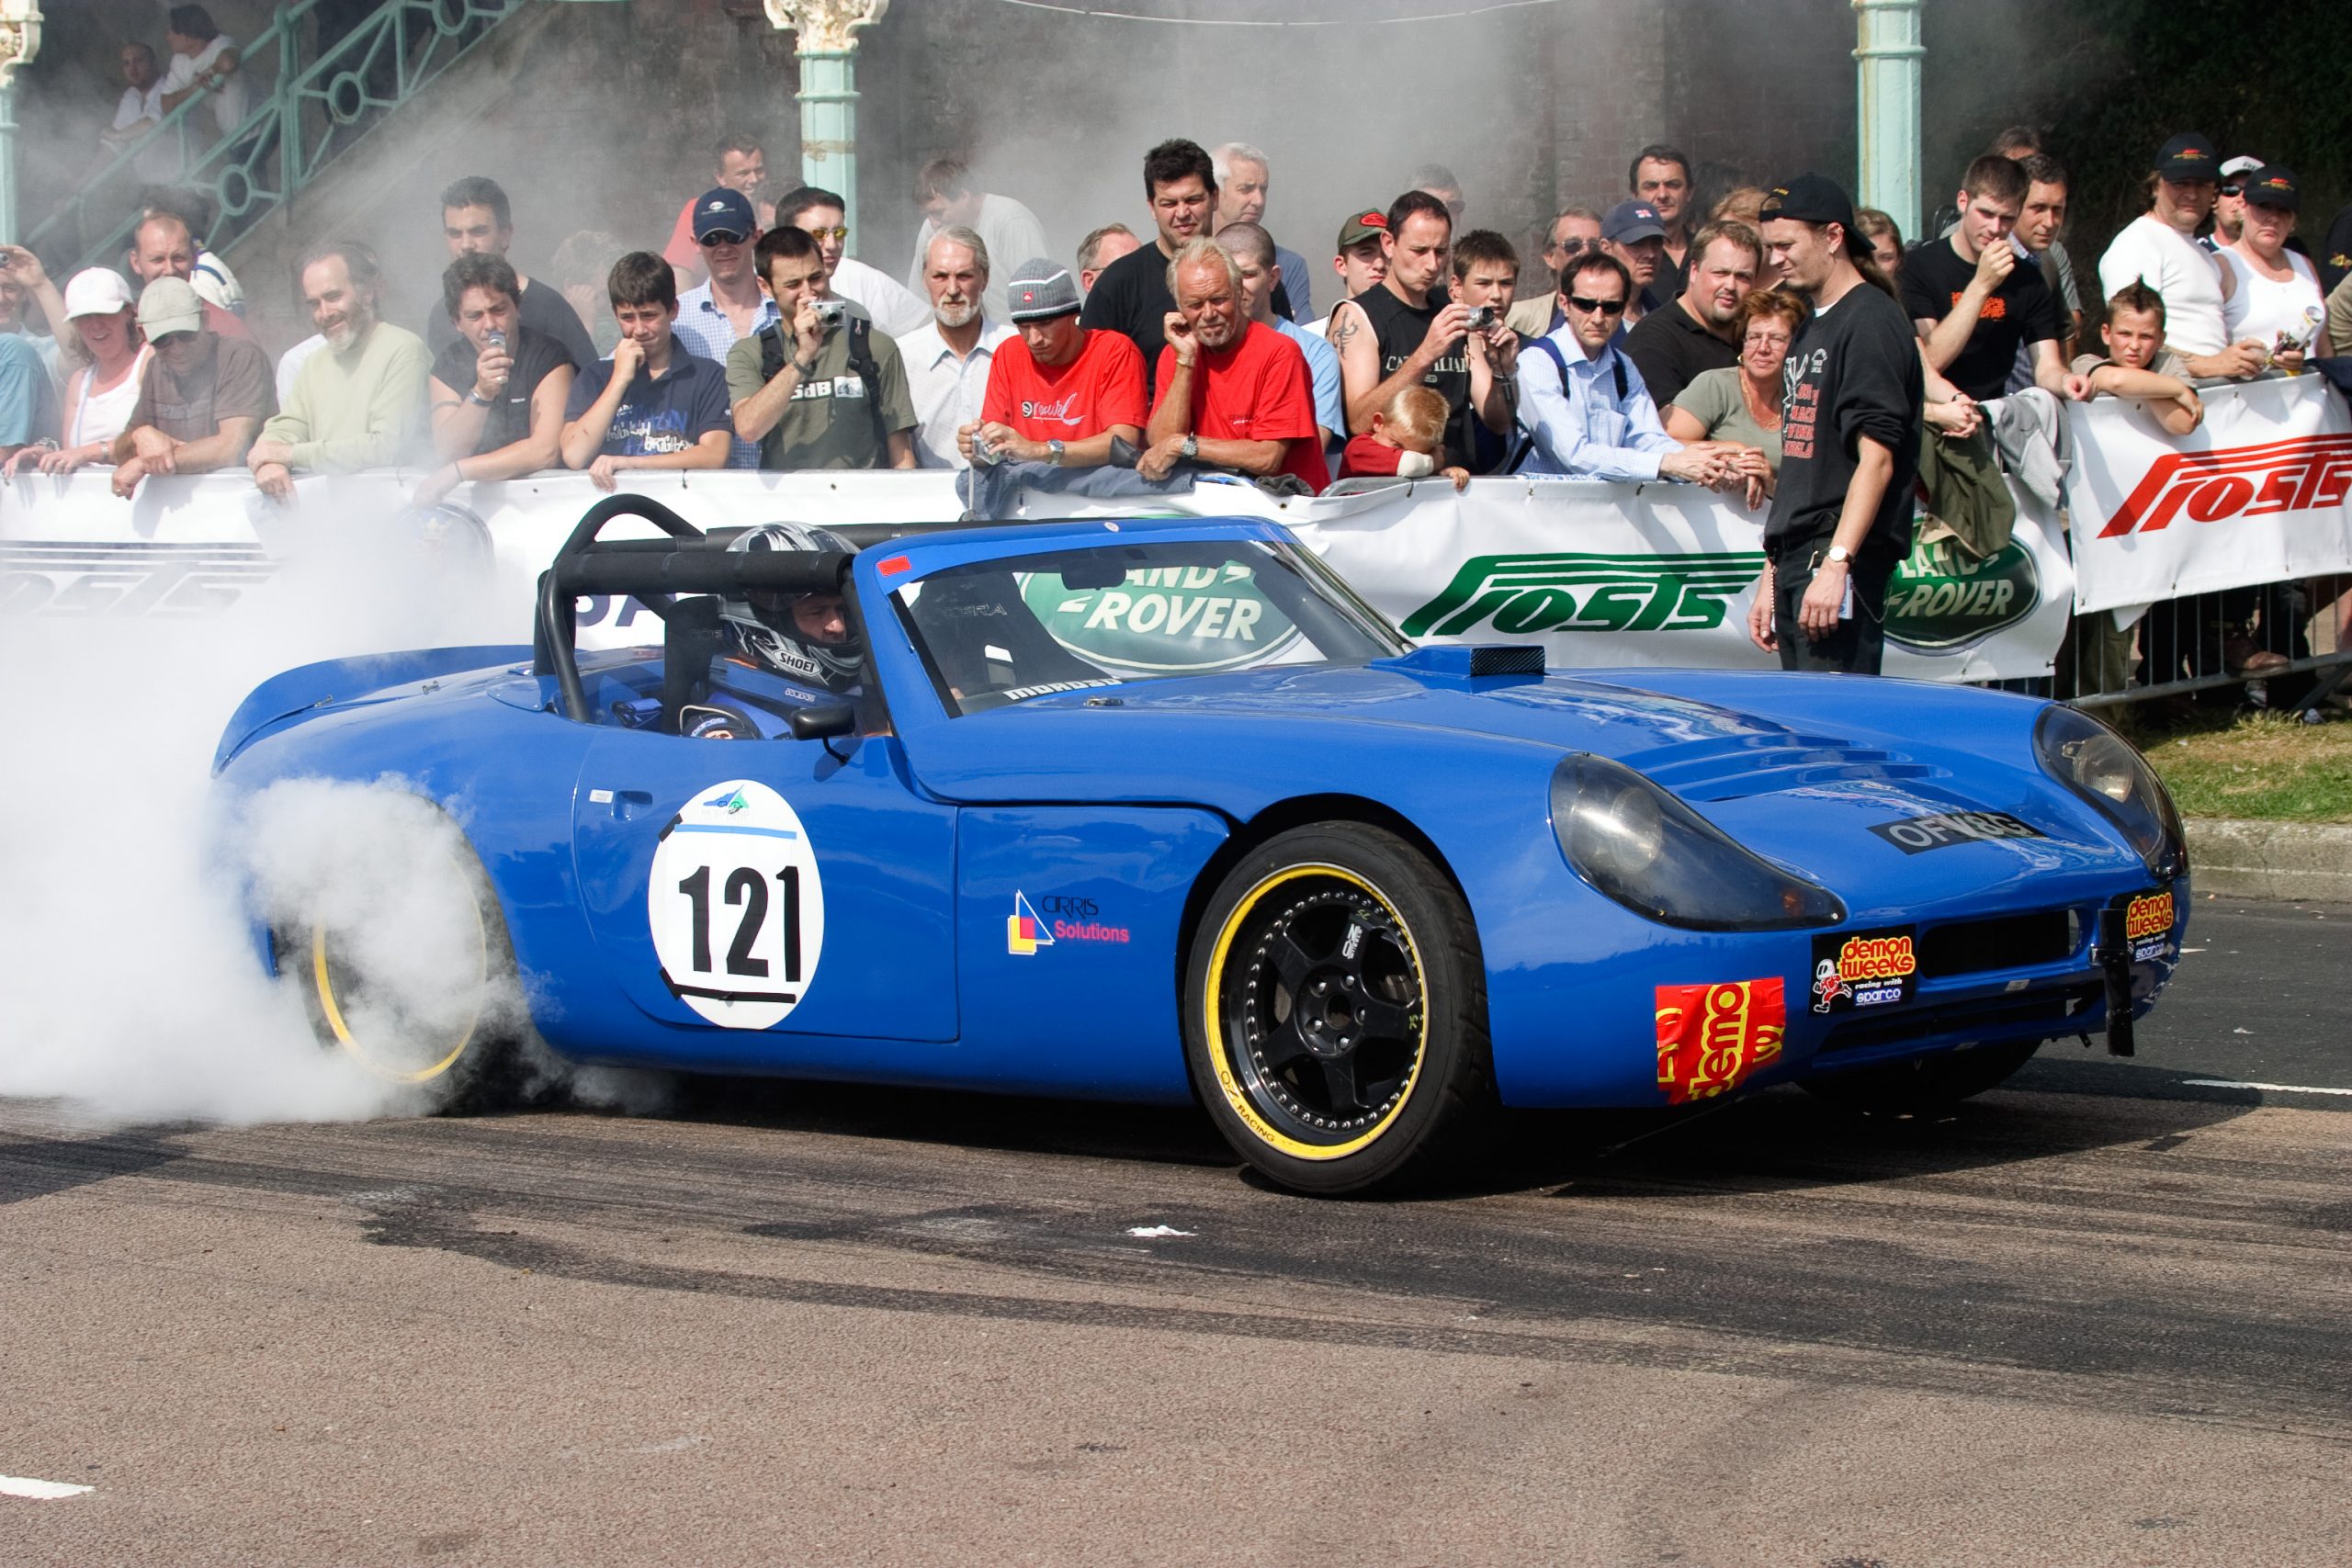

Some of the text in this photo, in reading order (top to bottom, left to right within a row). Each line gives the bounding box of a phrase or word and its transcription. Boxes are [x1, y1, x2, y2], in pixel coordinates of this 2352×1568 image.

[1895, 579, 2014, 618] ROVER
[1083, 592, 1262, 641] ROVER
[780, 653, 815, 673] SHOEI
[2127, 892, 2172, 919] demon
[679, 865, 801, 983] 121
[1054, 919, 1130, 942] Solutions
[2126, 909, 2174, 938] tweeks
[1841, 936, 1912, 960] demon
[1838, 953, 1915, 981] tweeks
[1855, 977, 1903, 990] racing with
[1856, 987, 1902, 1005] sparco
[1237, 1104, 1275, 1142] RACING
